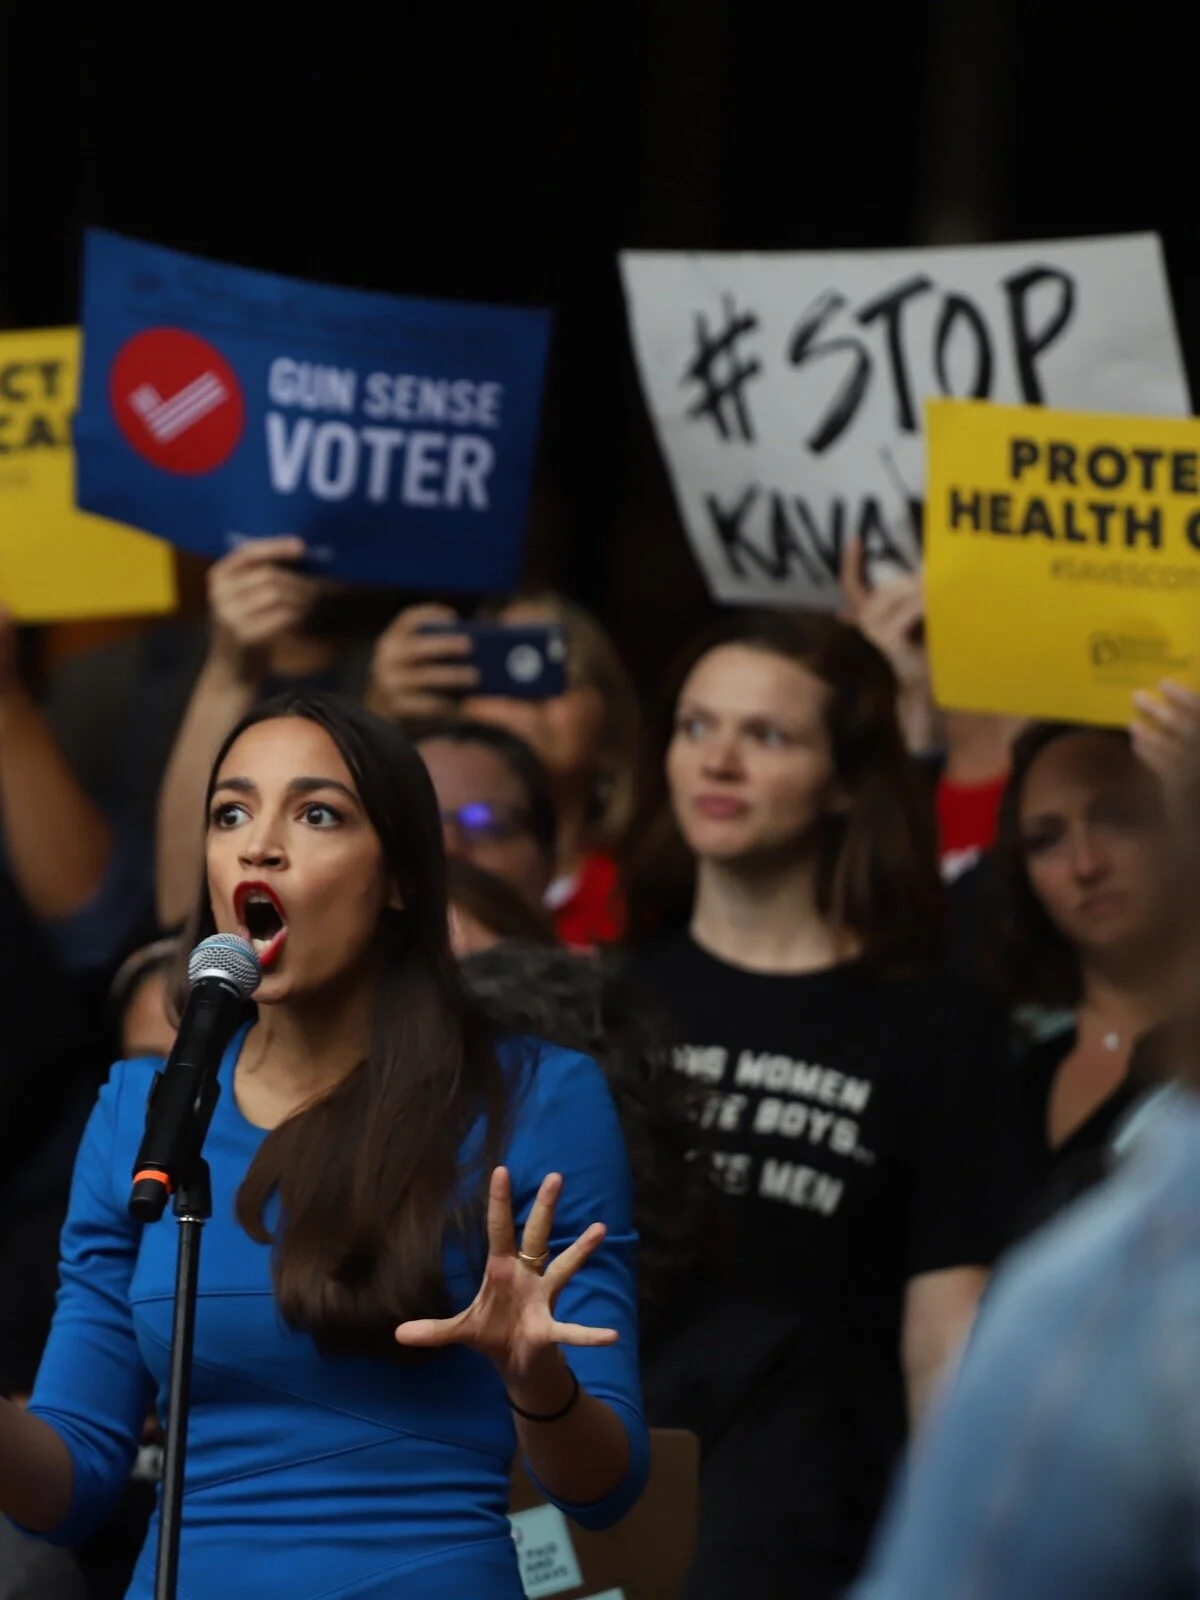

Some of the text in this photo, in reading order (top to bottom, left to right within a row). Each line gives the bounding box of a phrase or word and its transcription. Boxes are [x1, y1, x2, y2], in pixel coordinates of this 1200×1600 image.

[269, 355, 503, 429] GUN SENSE
[684, 262, 1078, 456] #STOP
[264, 408, 498, 511] VOTER
[1008, 436, 1200, 496] PROTE
[702, 485, 924, 592] KAVA
[947, 487, 1164, 552] HEALTH
[734, 1048, 872, 1114] WOMEN
[758, 1156, 845, 1218] MEN
